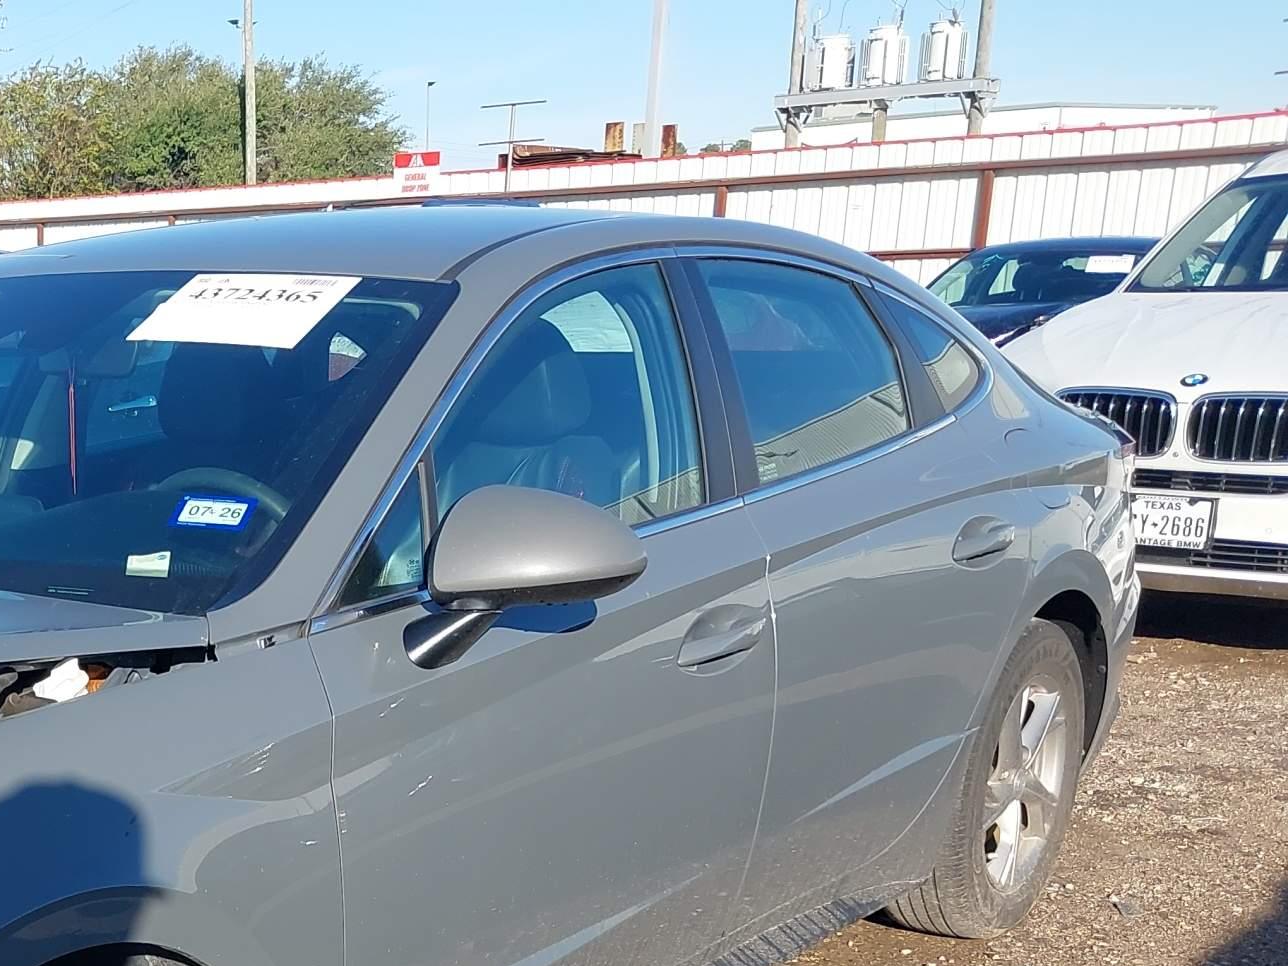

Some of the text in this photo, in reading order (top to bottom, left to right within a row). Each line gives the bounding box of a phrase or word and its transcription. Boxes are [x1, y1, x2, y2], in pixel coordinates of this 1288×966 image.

[188, 287, 325, 304] 43724365
[187, 504, 244, 519] 07 26
[1144, 501, 1182, 511] TEXAS
[1176, 540, 1202, 549] BMW
